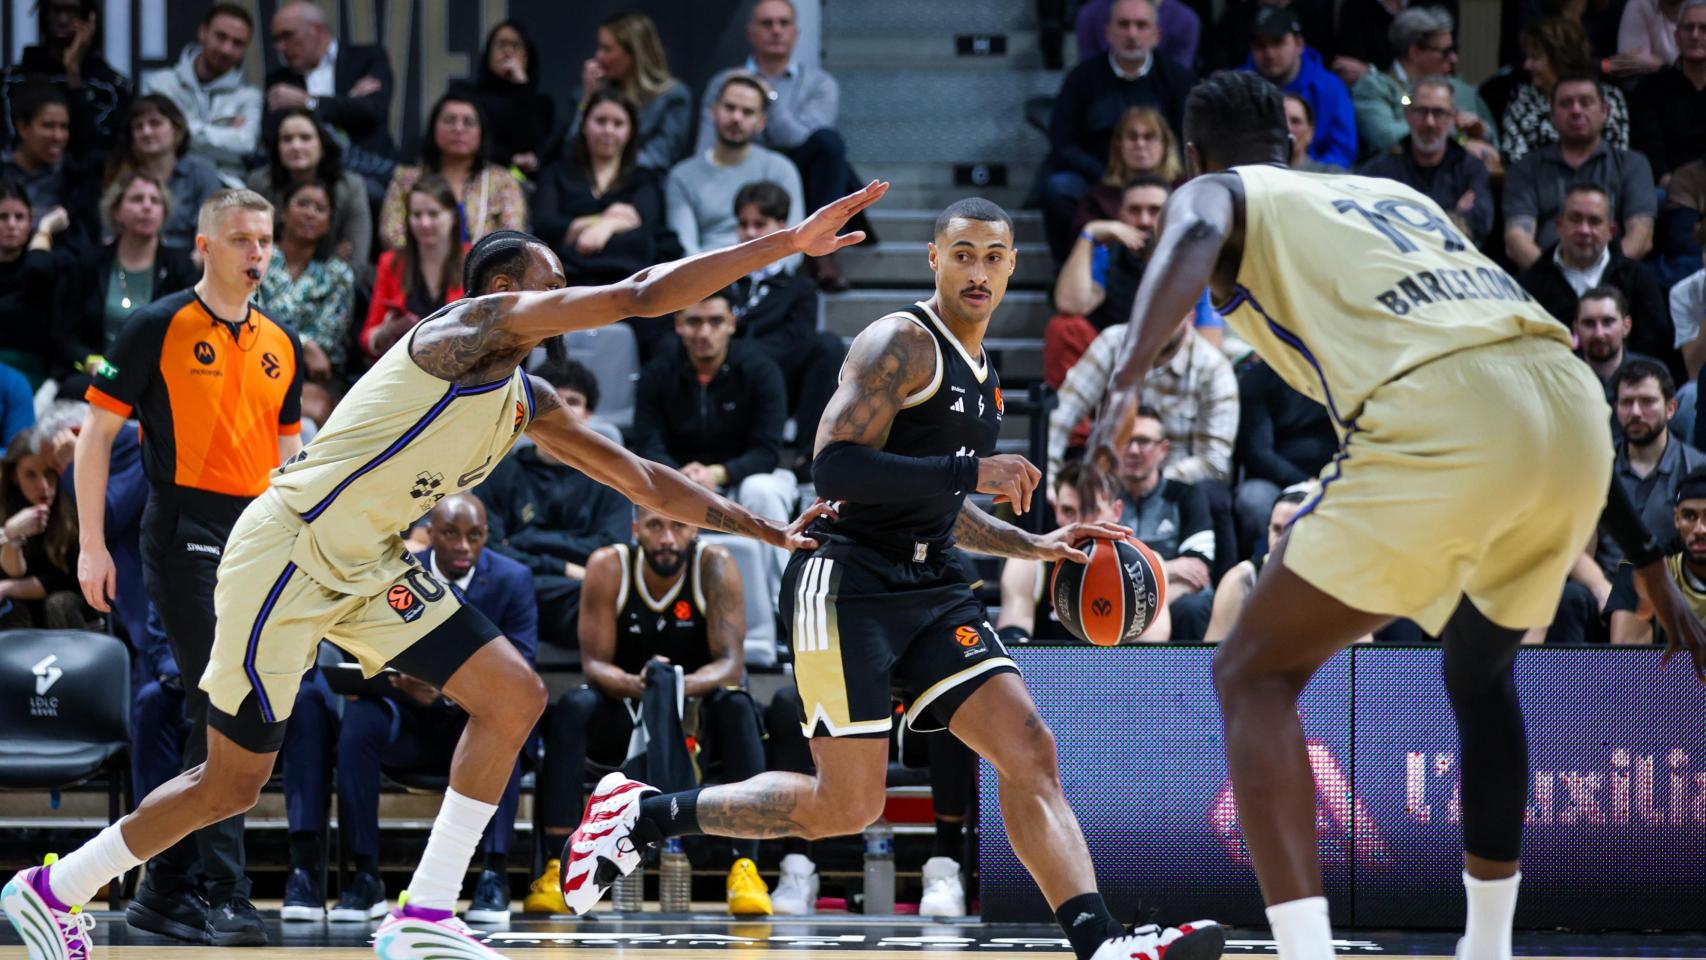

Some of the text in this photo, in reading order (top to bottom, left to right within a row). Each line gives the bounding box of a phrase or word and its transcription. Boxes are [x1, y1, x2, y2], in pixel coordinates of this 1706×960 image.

[1331, 199, 1466, 254] 19
[1123, 560, 1147, 640] SPALDING
[1406, 748, 1706, 824] l'uxili
